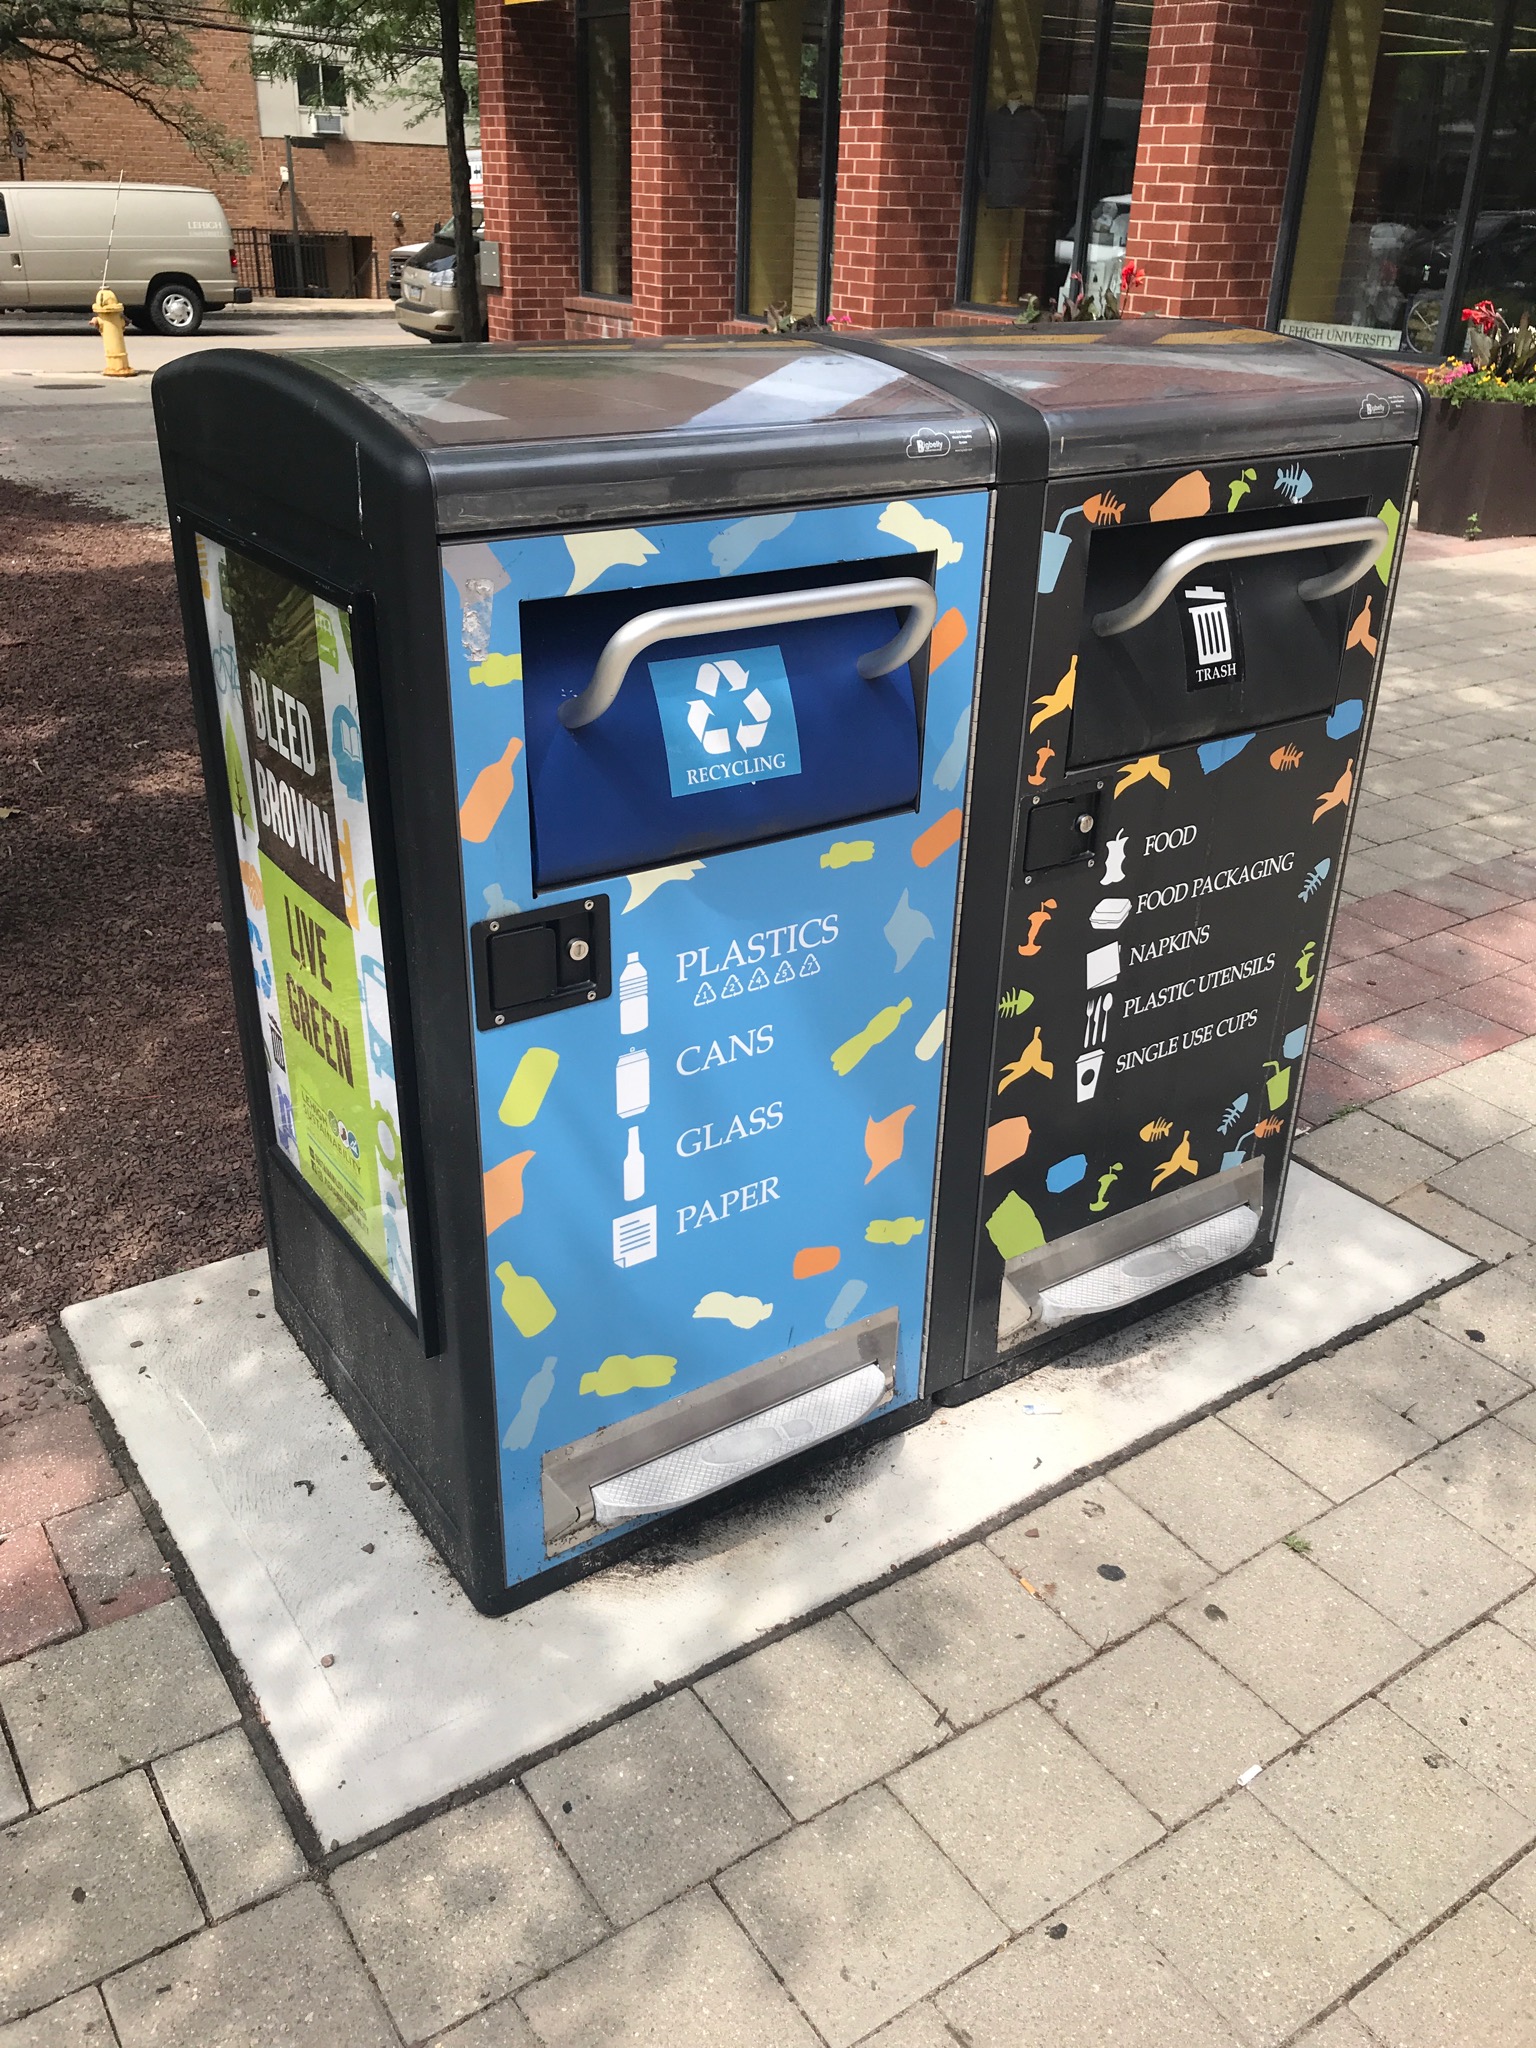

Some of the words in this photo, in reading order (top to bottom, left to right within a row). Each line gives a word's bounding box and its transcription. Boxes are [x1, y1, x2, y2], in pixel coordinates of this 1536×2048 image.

[1282, 324, 1324, 340] LEHIGH
[1327, 328, 1395, 348] UNIVERSITY
[916, 440, 943, 453] Bigbelly
[1196, 662, 1237, 682] TRASH
[249, 668, 316, 778] BLEED
[686, 752, 786, 786] RECYCLING
[255, 757, 336, 884] BROWN
[1143, 824, 1198, 857] FOOD
[1136, 884, 1189, 915] FOOD
[1191, 851, 1295, 899] PACKAGING
[284, 895, 332, 993] LIVE
[676, 914, 840, 983] PLASTICS
[1128, 925, 1210, 967] NAPKINS
[1122, 986, 1196, 1019] PLASTIC
[1198, 952, 1276, 994] UTENSILS
[286, 972, 354, 1089] GREEN
[676, 1024, 775, 1077] CANS
[1115, 1040, 1180, 1074] SINGLE
[1182, 1023, 1213, 1050] USE
[1215, 1008, 1258, 1038] CUPS
[301, 1090, 328, 1126] LEHIGH
[676, 1101, 784, 1158] GLASS
[303, 1103, 362, 1175] SUSTAINABILITY
[676, 1176, 780, 1236] PAPER
